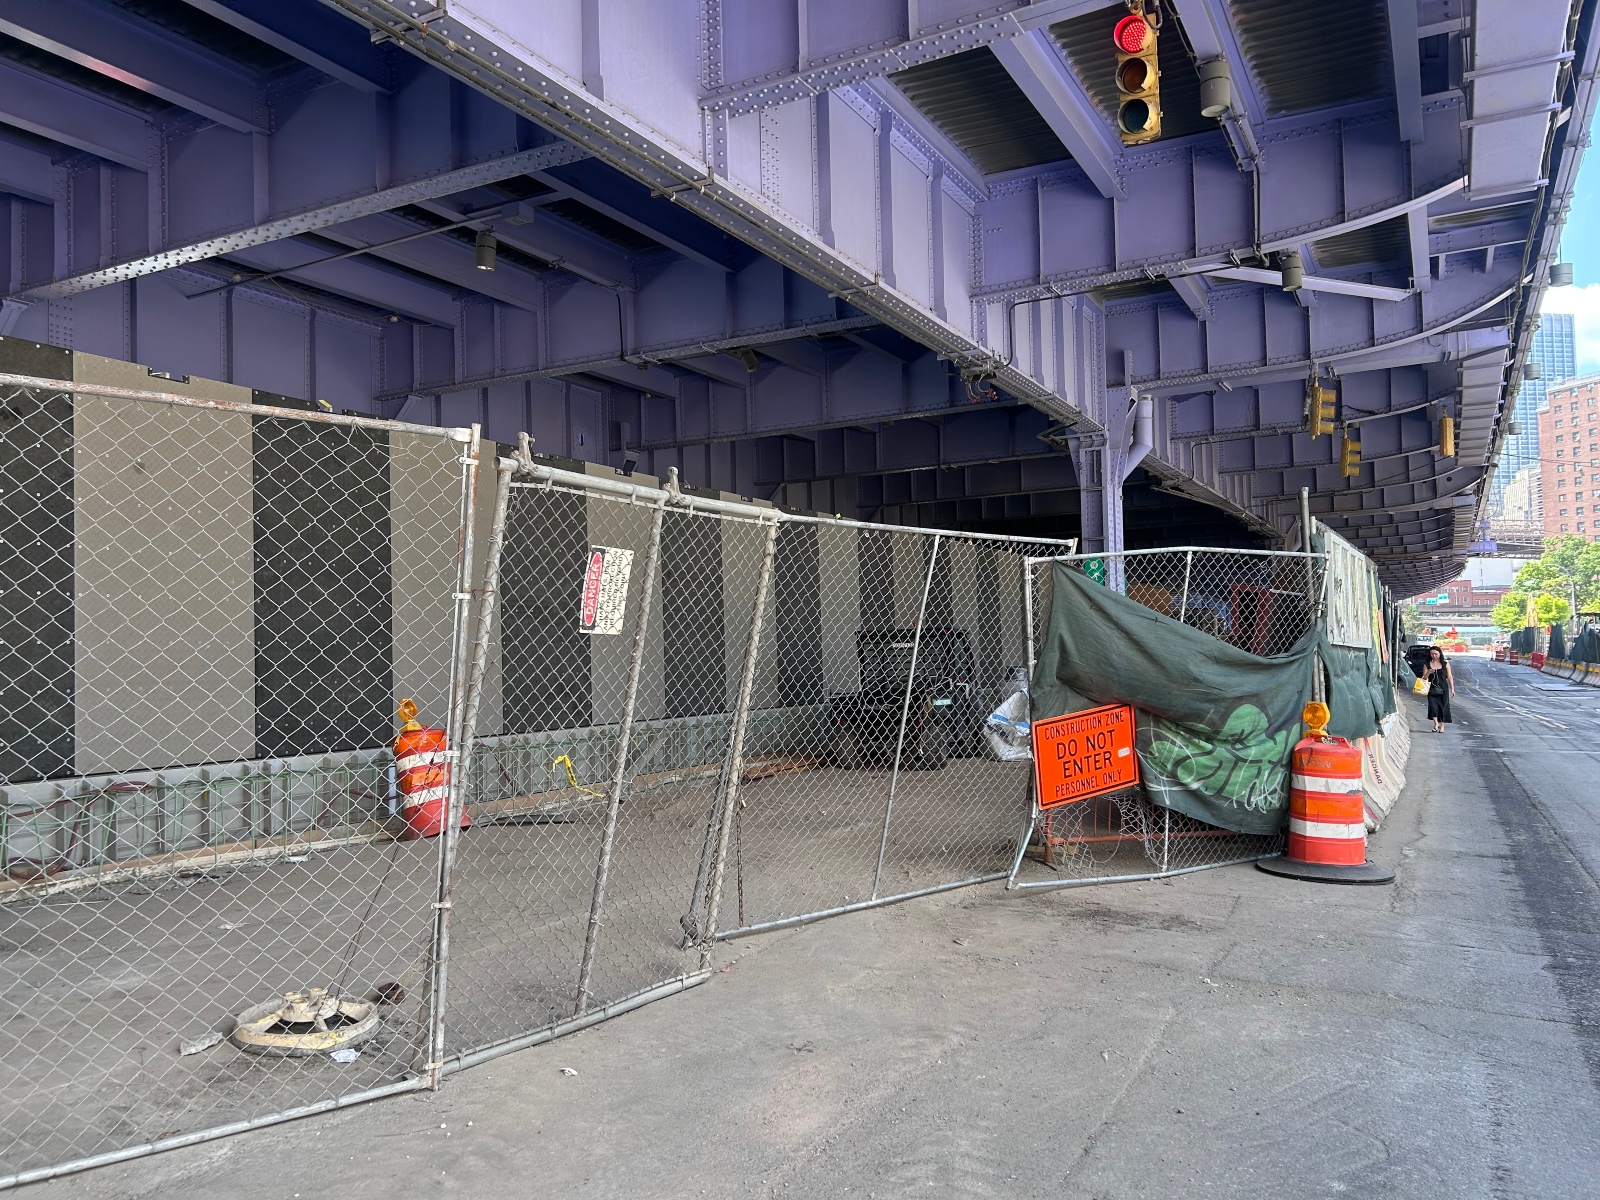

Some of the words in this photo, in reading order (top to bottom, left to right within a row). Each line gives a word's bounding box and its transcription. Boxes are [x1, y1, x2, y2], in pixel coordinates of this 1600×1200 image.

[586, 563, 600, 615] DANGER
[1044, 716, 1102, 740] CONSTRUCTION
[1105, 710, 1124, 726] ZONE
[1056, 739, 1078, 760] DO
[1085, 729, 1115, 753] NOT
[1063, 751, 1113, 779] ENTER
[1055, 775, 1099, 798] PERSONNEL
[1102, 769, 1122, 785] ONLY
